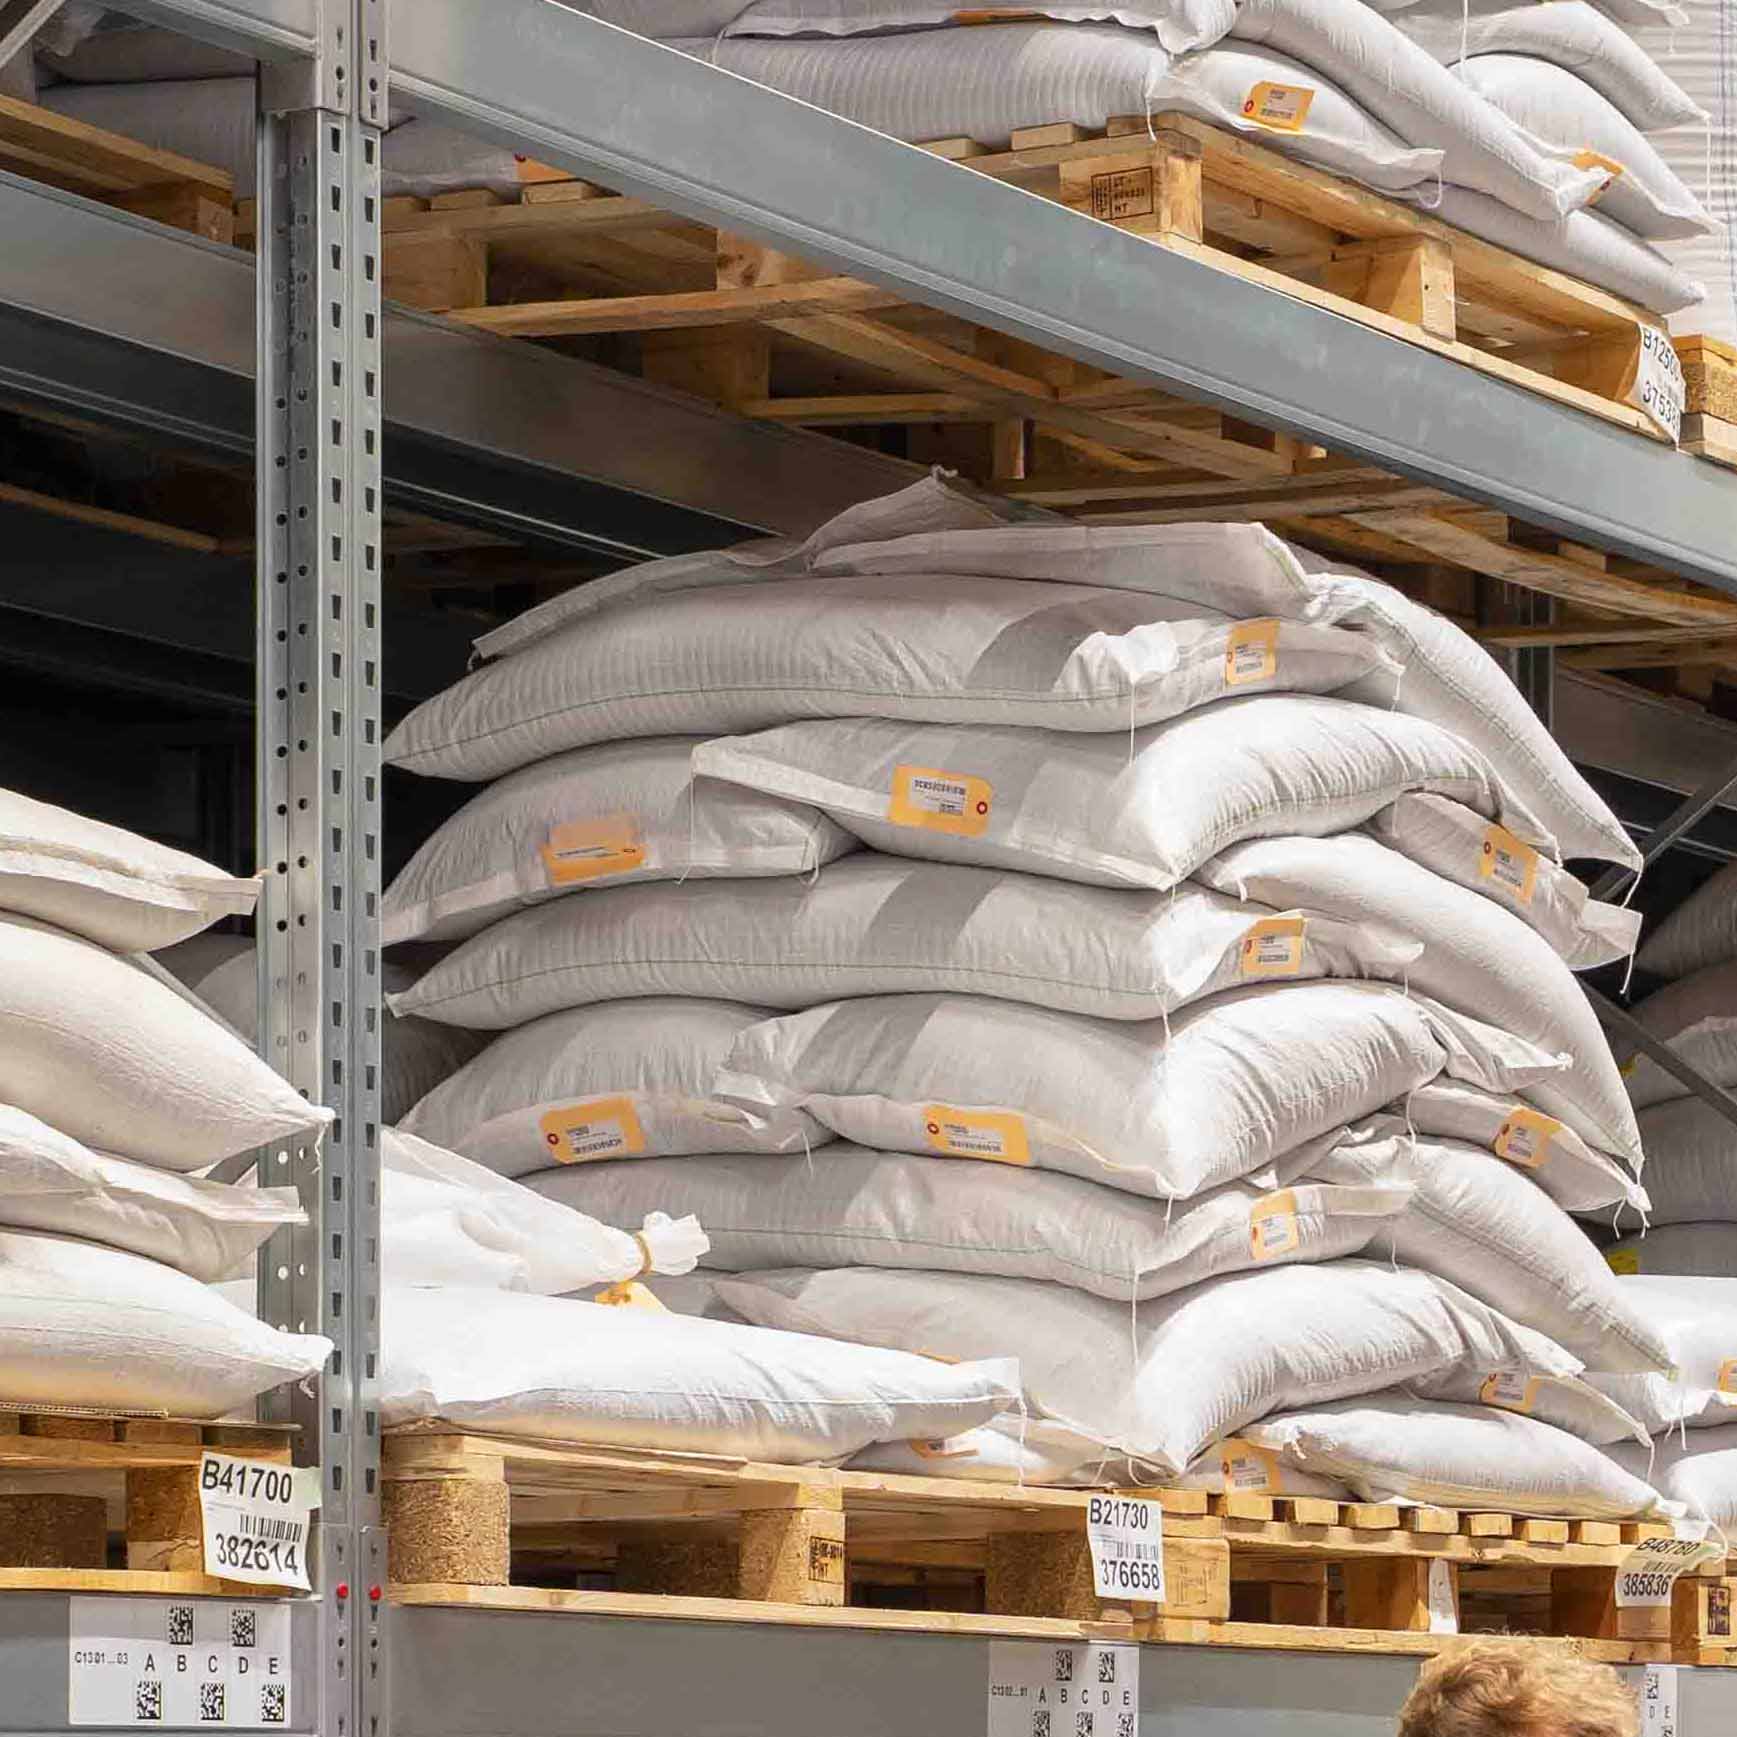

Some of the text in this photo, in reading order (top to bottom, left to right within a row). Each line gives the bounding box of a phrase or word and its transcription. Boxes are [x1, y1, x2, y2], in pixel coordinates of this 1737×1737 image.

[202, 1460, 292, 1503] B41700
[1090, 1498, 1148, 1529] B21730
[216, 1533, 298, 1576] 382614
[1101, 1559, 1161, 1590] 376658
[1623, 1573, 1673, 1597] 385836
[144, 1653, 156, 1672] A
[176, 1654, 187, 1672] B
[208, 1655, 218, 1673] C
[238, 1656, 249, 1674] D
[268, 1657, 278, 1675] E
[1038, 1687, 1047, 1704] A
[1060, 1687, 1068, 1704] B
[1081, 1689, 1089, 1705] C
[1102, 1689, 1110, 1705] D
[1123, 1690, 1130, 1706] E
[1664, 1704, 1672, 1719] E
